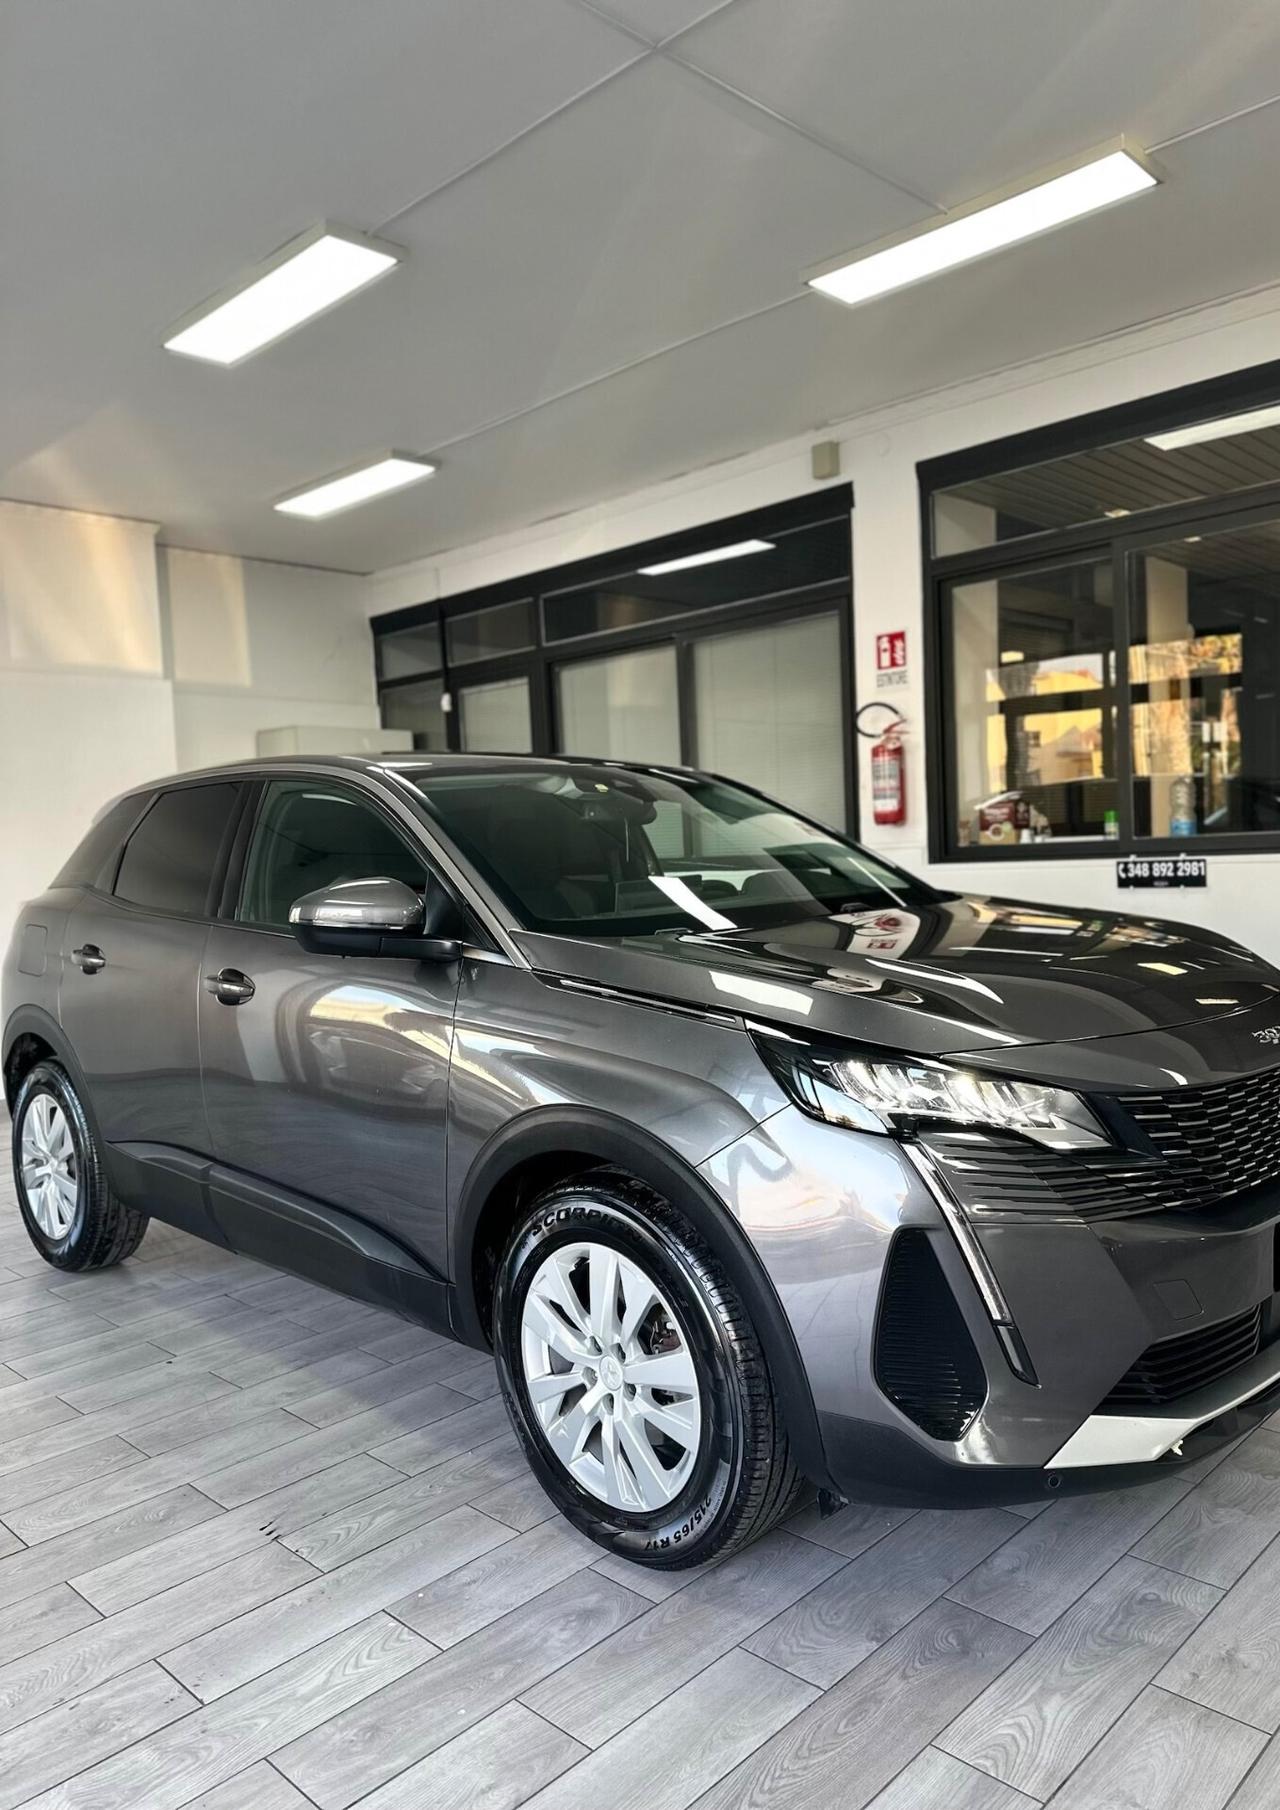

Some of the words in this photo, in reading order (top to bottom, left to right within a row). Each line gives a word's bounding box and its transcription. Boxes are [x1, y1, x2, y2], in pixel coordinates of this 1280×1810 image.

[1128, 862, 1149, 877] 348
[1152, 862, 1174, 877] 892
[1177, 861, 1205, 876] 2981
